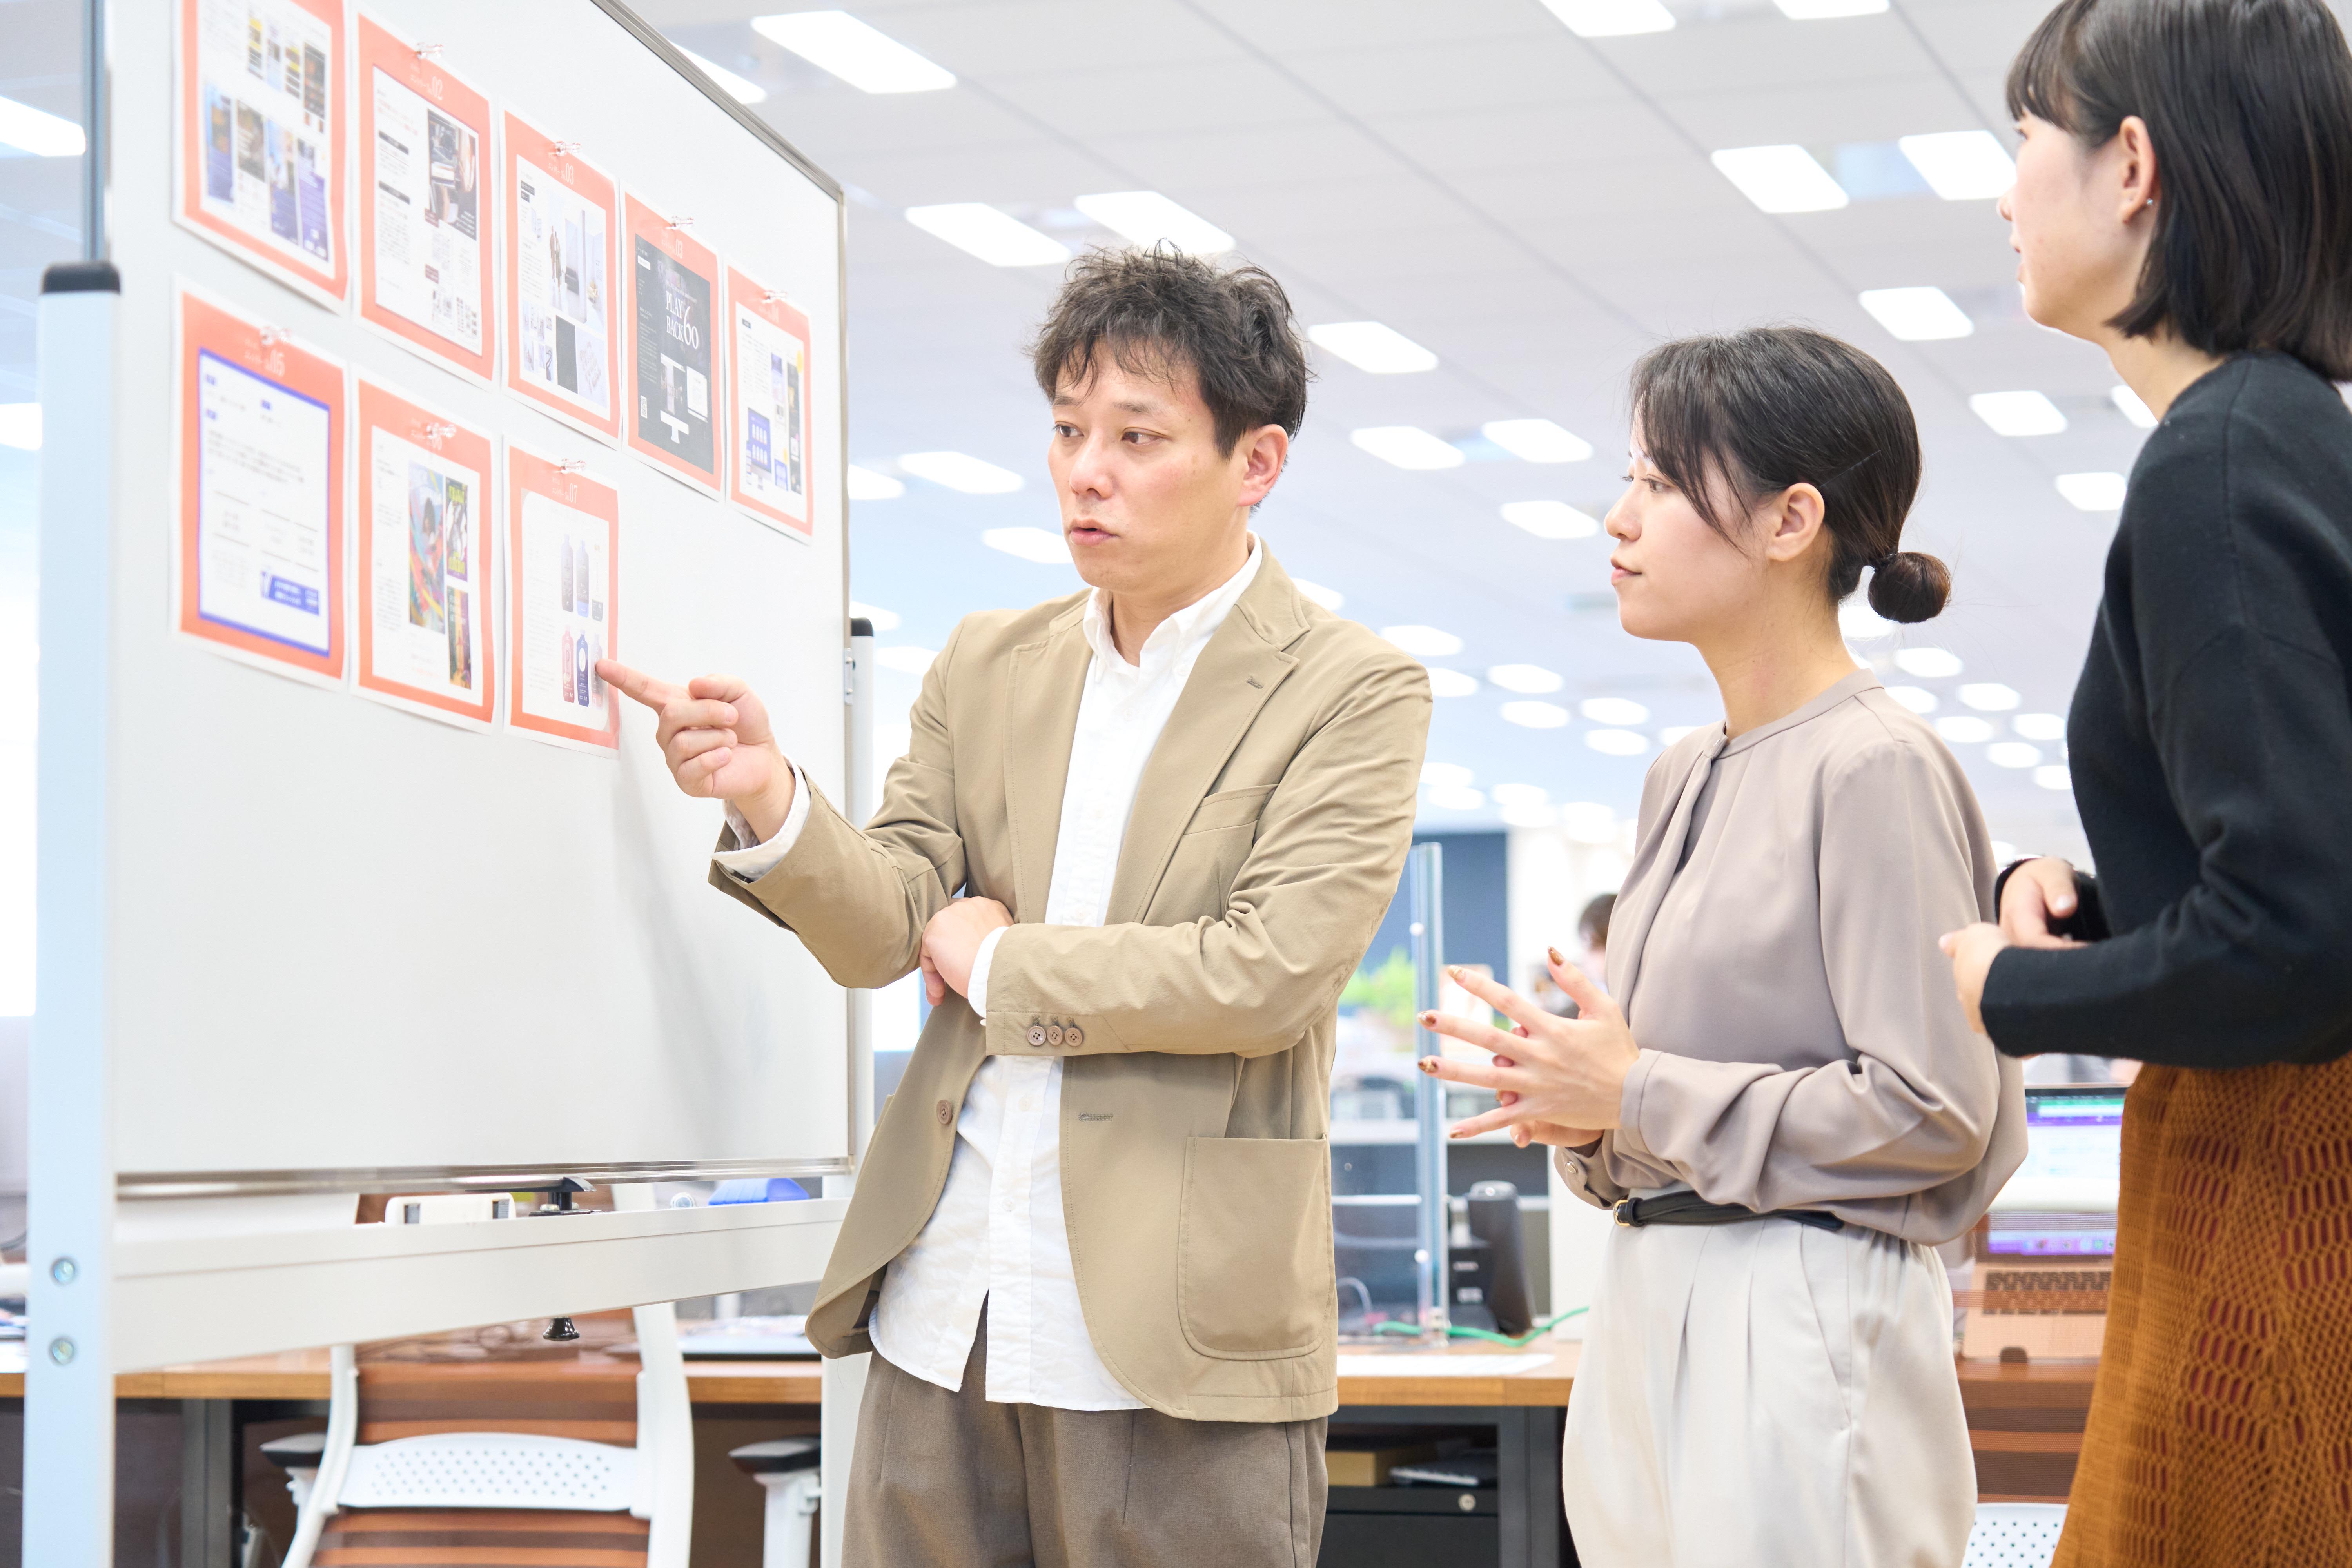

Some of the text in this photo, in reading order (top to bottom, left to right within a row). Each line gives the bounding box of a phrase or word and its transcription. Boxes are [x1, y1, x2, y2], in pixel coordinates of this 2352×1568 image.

[666, 290, 683, 319] PLAY
[666, 315, 684, 343] BACK
[684, 306, 699, 349] 60
